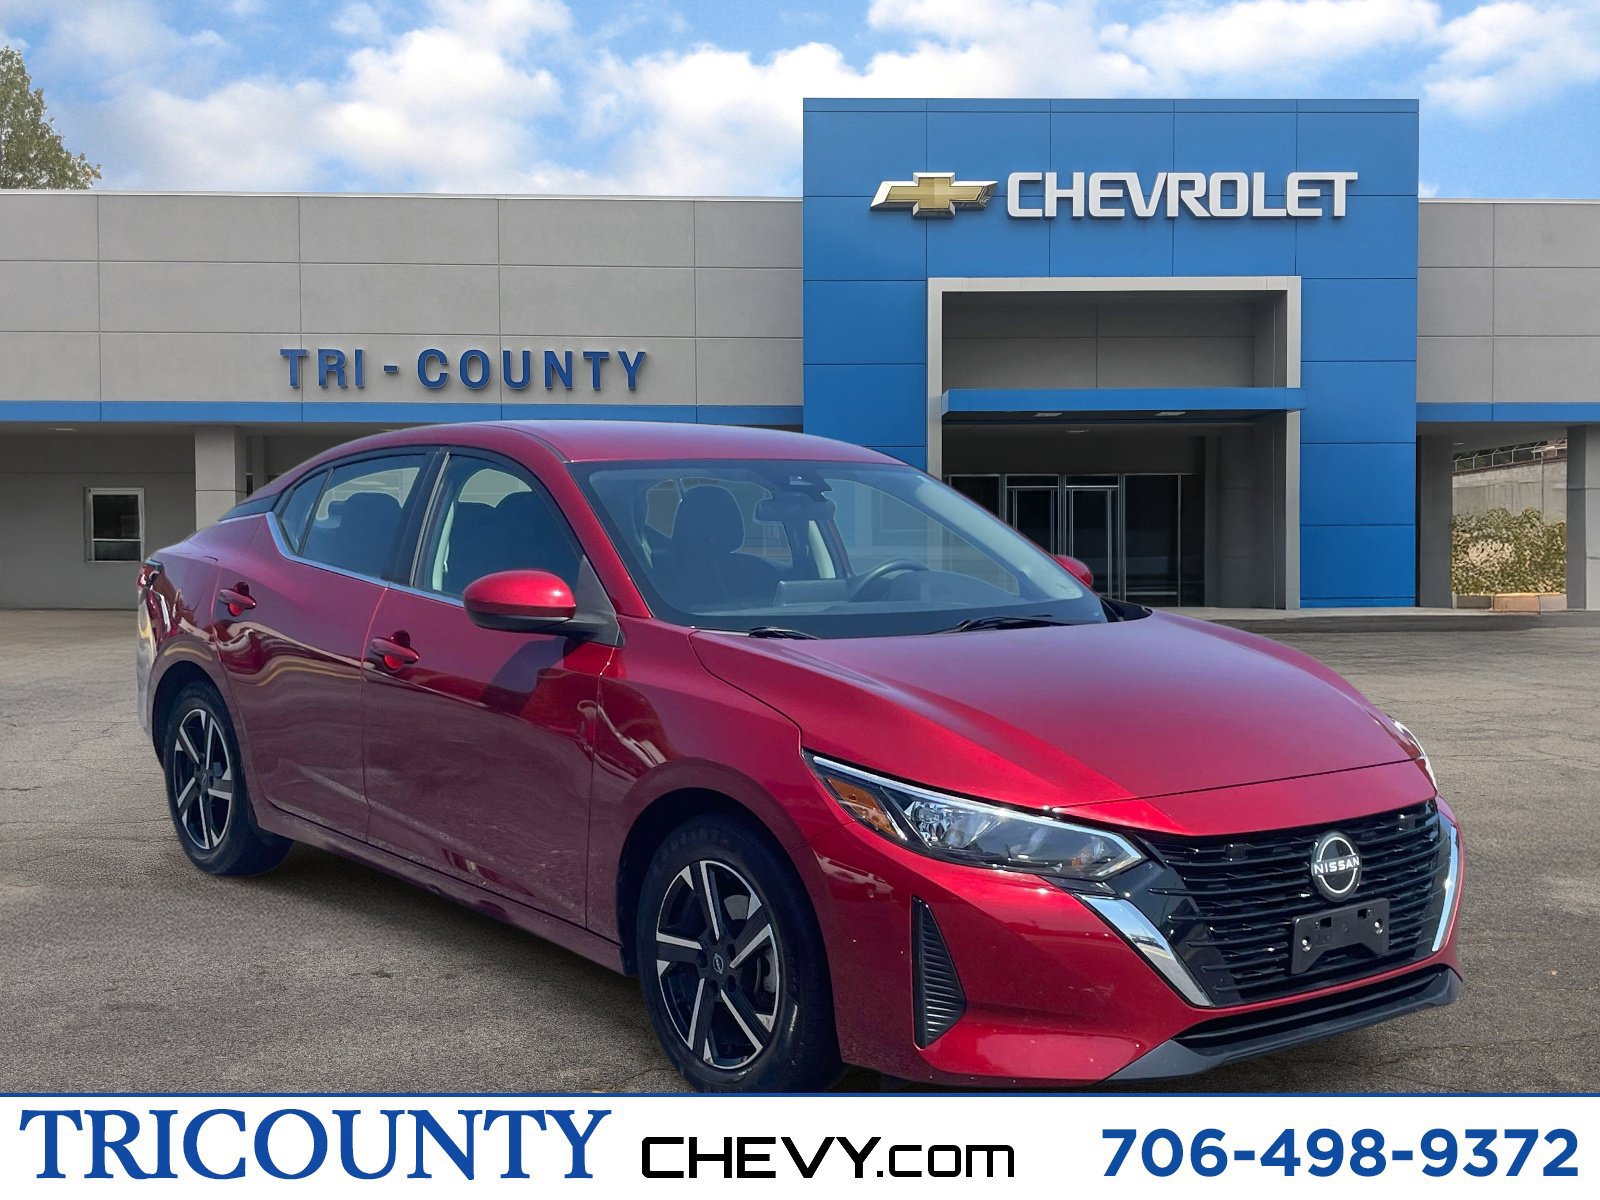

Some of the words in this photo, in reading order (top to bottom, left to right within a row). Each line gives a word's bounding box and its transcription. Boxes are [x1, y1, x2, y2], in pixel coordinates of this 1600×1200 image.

[1007, 171, 1358, 219] CHEVROLET
[280, 348, 366, 390] TRI
[417, 348, 648, 391] COUNTY
[1313, 856, 1360, 875] NISSAN
